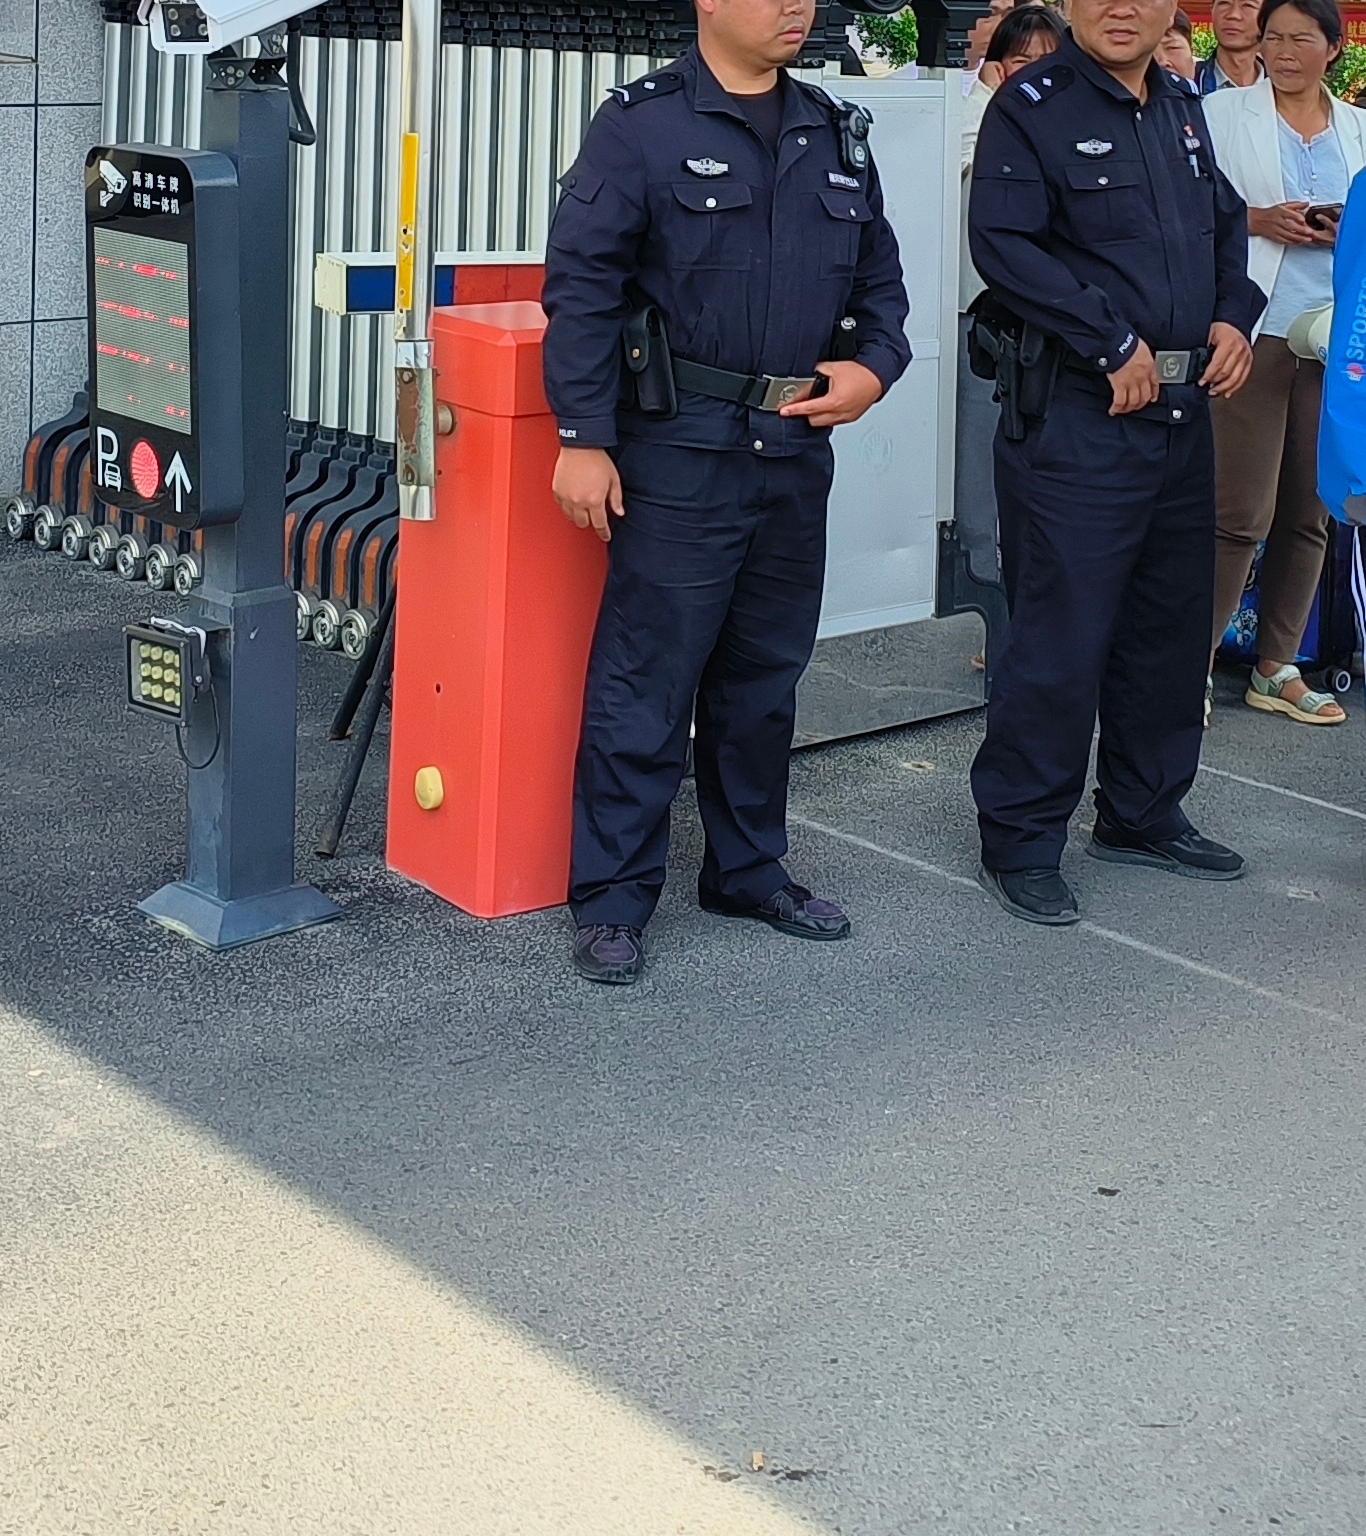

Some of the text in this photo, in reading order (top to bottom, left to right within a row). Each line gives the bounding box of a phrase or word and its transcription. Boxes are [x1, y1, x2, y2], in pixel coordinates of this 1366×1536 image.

[131, 170, 179, 193] 高清车牌
[133, 192, 180, 215] 识别一体机
